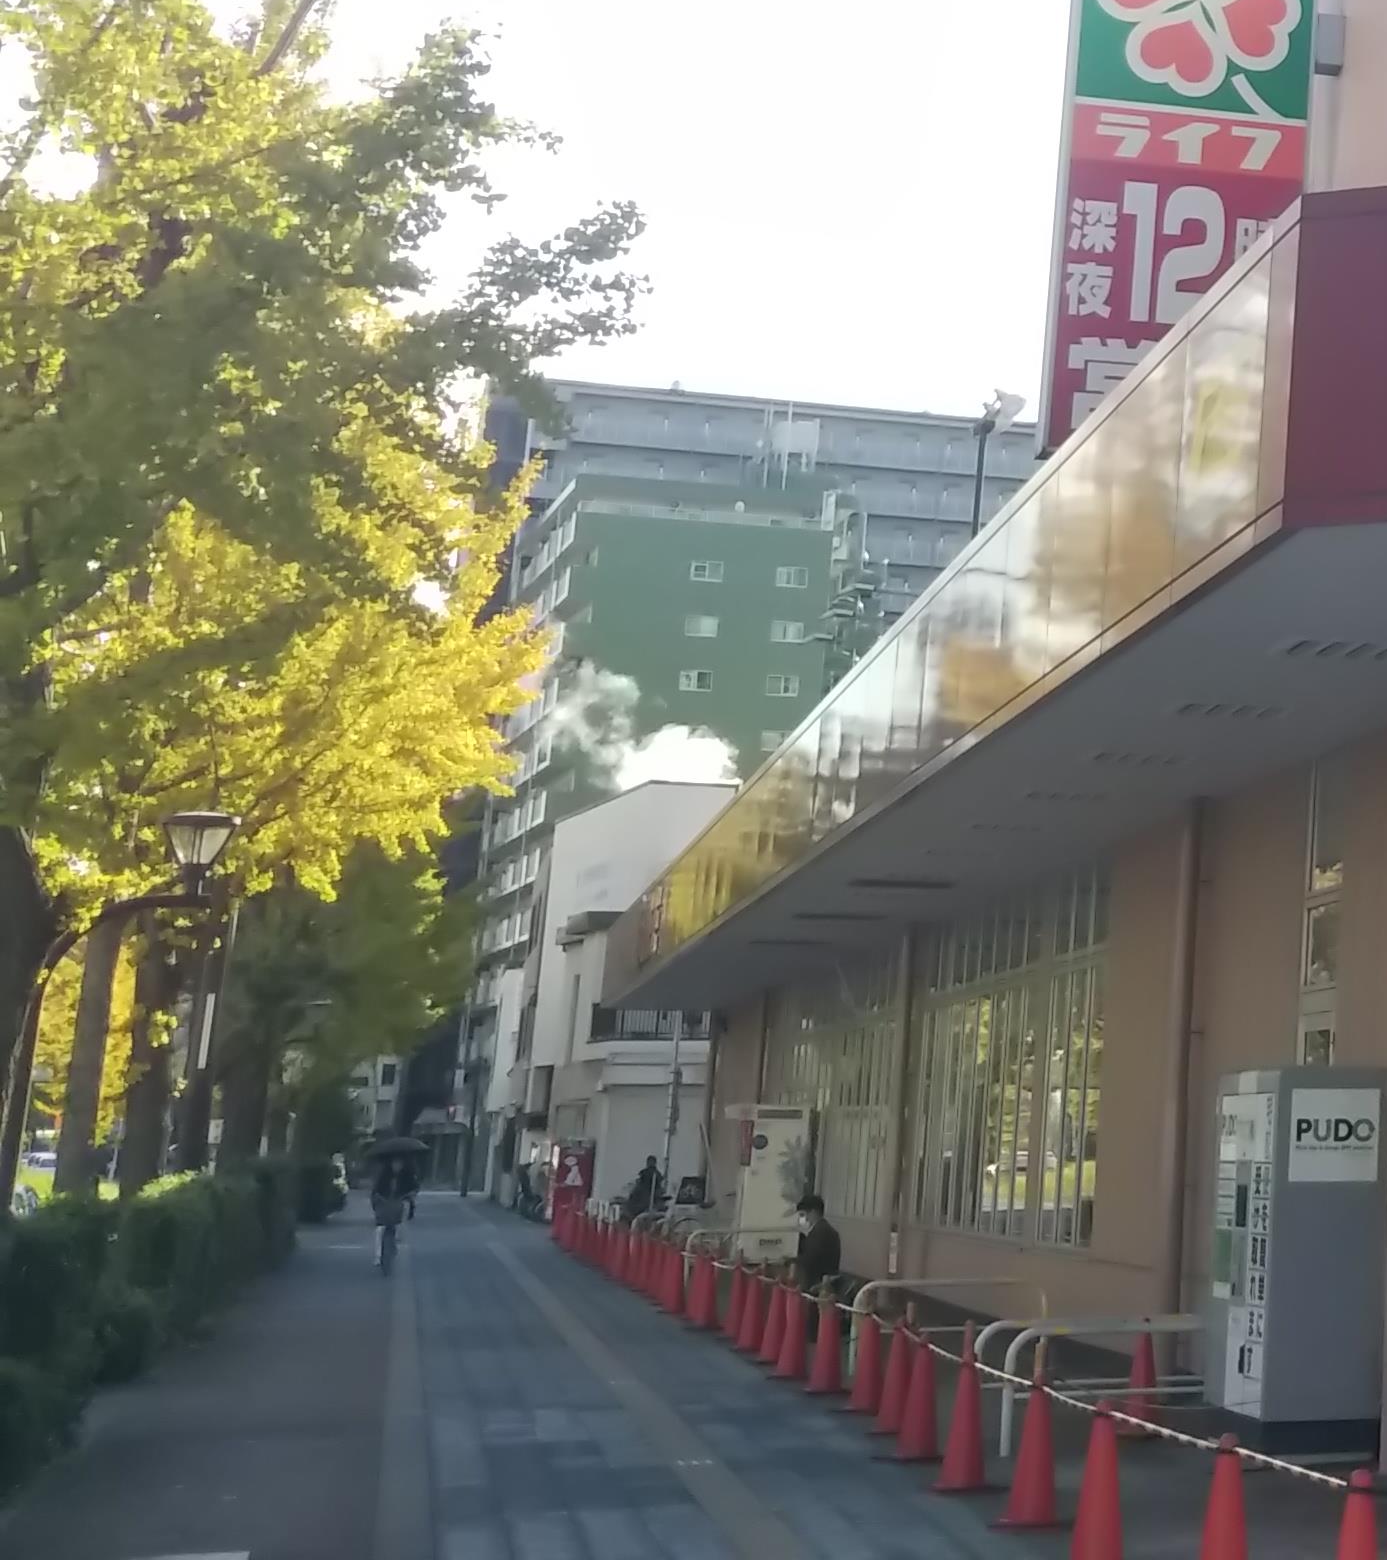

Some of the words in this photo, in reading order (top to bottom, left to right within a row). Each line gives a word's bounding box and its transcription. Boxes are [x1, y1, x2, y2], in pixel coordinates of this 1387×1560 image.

[1096, 112, 1282, 171] ライフ
[1066, 197, 1119, 319] 深夜
[1296, 1118, 1376, 1142] PUDO
